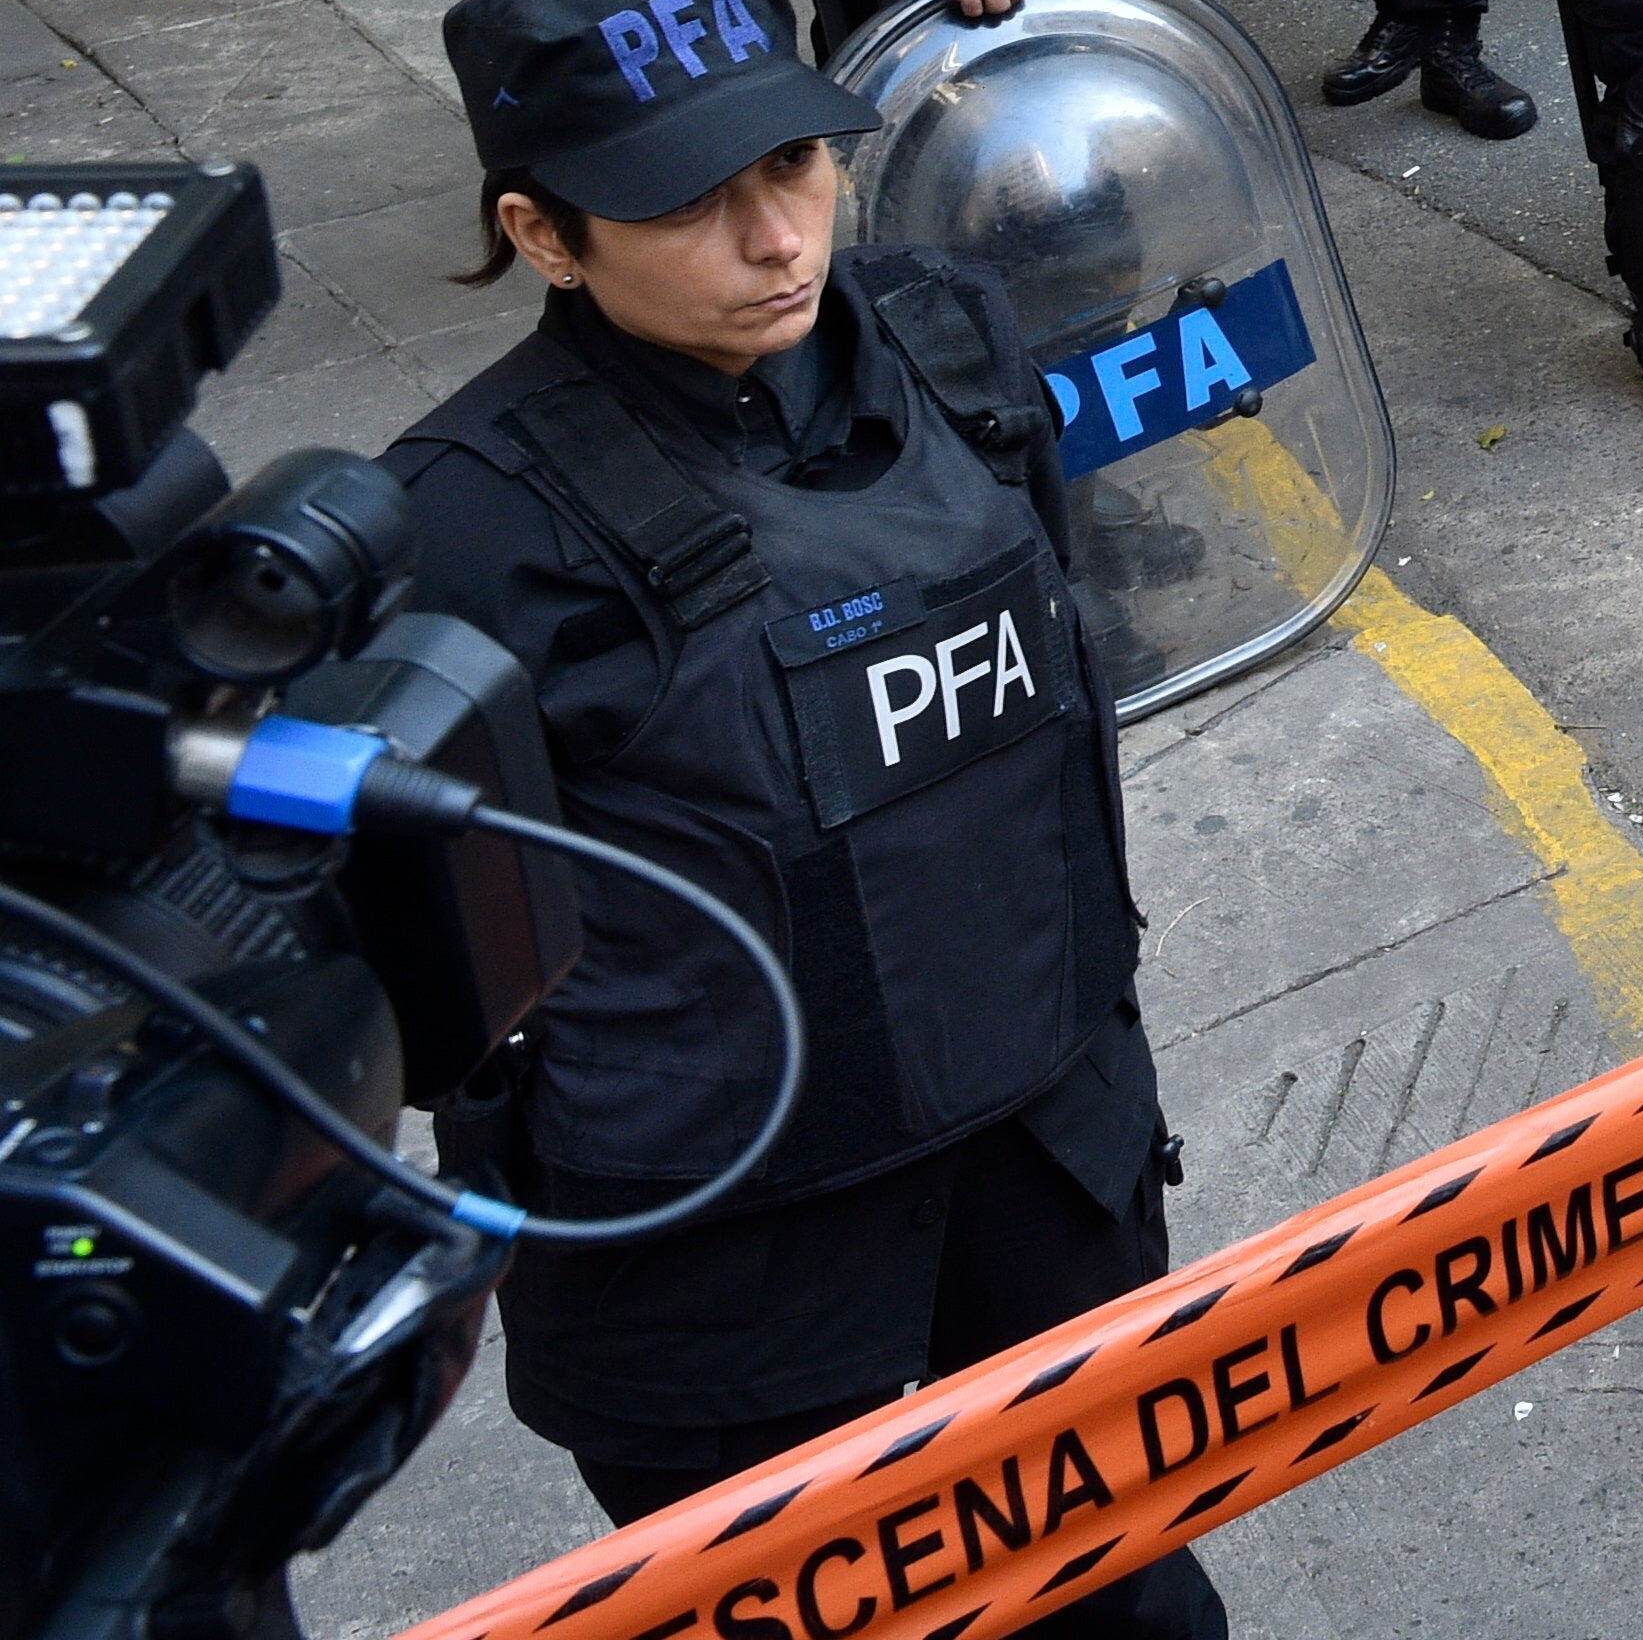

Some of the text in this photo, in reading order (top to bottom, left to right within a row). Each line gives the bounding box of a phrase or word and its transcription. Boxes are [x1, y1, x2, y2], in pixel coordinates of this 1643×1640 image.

[808, 591, 884, 633] B.D. BOSC
[826, 627, 867, 649] CABO
[866, 608, 1037, 768] PFA
[625, 1425, 1116, 1640] SCENA
[1136, 1322, 1340, 1484] DEL
